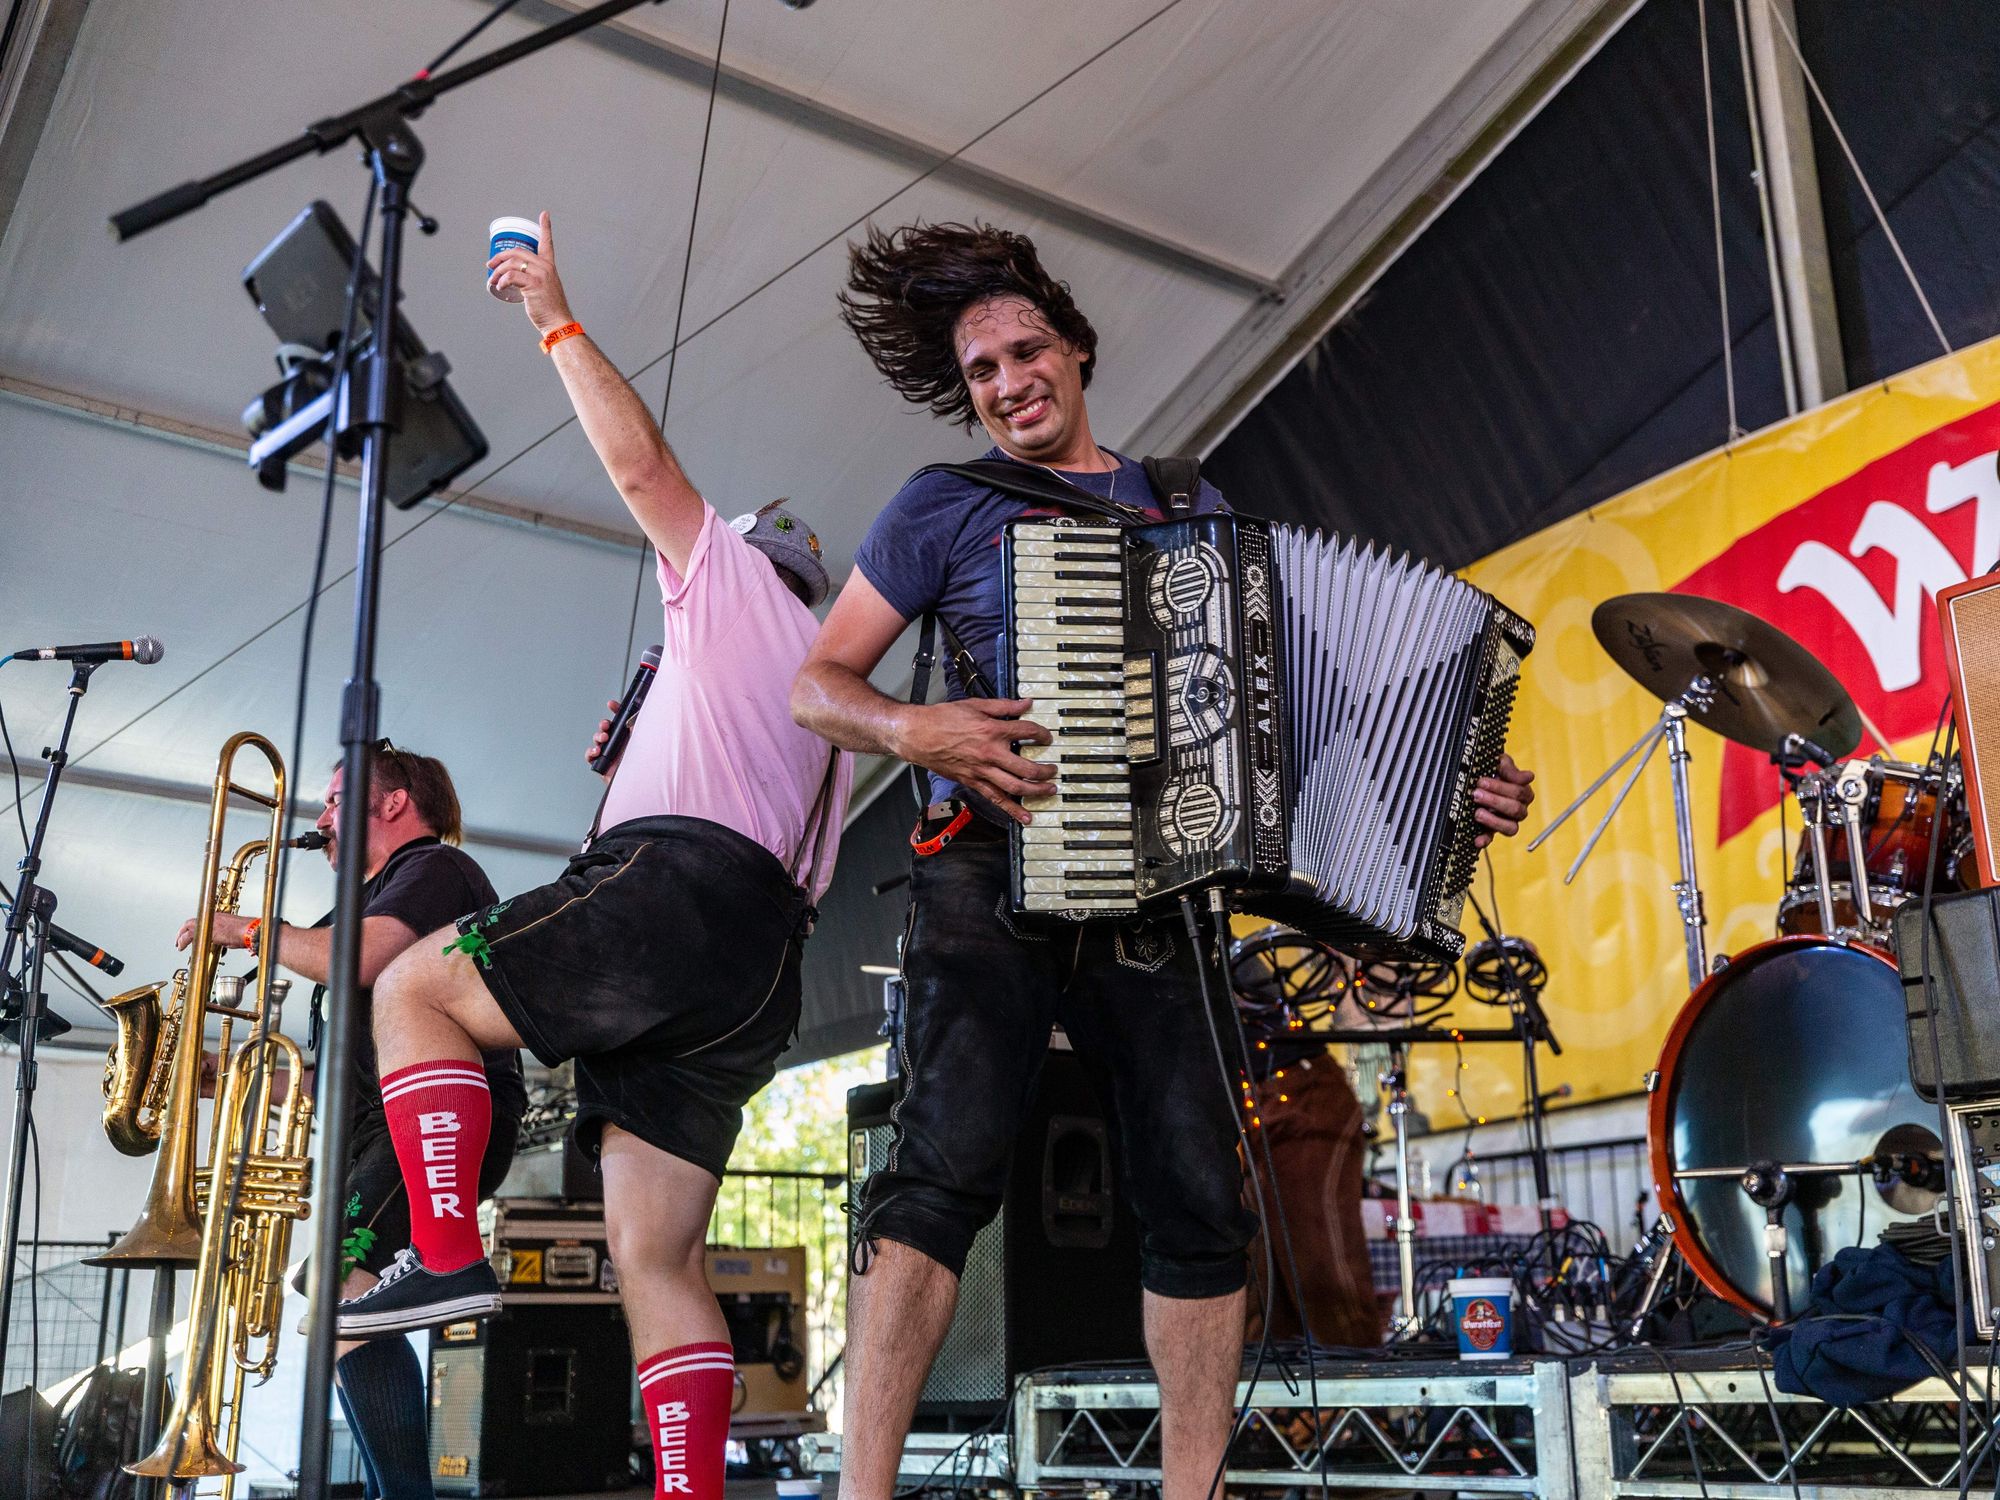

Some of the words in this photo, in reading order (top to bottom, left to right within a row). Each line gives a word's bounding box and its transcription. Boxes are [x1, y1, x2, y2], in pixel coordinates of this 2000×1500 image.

[1253, 653, 1272, 735] ALEX
[1448, 770, 1468, 822] SUPER
[1461, 715, 1481, 766] POLKA
[417, 1110, 465, 1218] BEER
[656, 1401, 694, 1493] BEER
